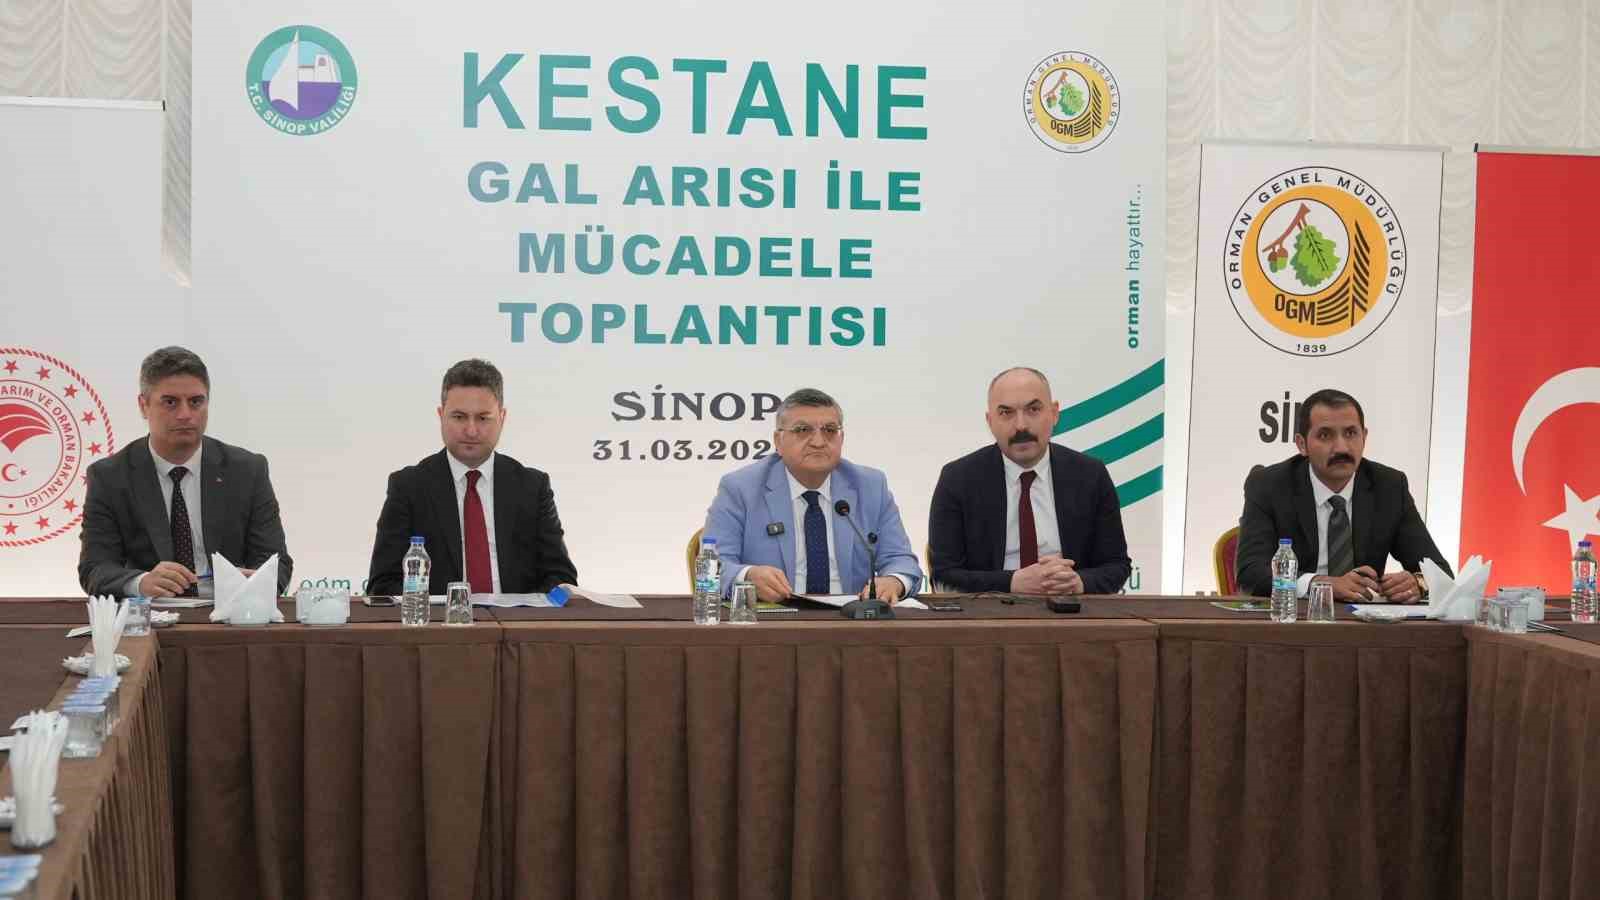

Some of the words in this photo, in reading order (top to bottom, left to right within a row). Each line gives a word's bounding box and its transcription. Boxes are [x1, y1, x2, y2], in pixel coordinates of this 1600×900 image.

[463, 51, 928, 140] KESTANE
[1050, 120, 1074, 137] OGM
[467, 161, 598, 204] GAL
[622, 165, 797, 209] ARISI
[826, 159, 921, 211] İLE
[518, 224, 873, 279] MÜCADELE
[1229, 213, 1253, 290] ORMAN
[1258, 172, 1323, 204] GENEL
[1336, 176, 1405, 295] MÜDÜRLÜĞÜ
[498, 302, 887, 347] TOPLANTISI
[1127, 279, 1140, 350] orman
[1274, 293, 1316, 326] OGM
[1296, 343, 1328, 353] 1839
[0, 384, 34, 399] ARIM
[38, 393, 54, 408] VE
[52, 406, 76, 451] ORMAN
[611, 384, 783, 422] SİNOP
[592, 439, 772, 461] 31.03.202
